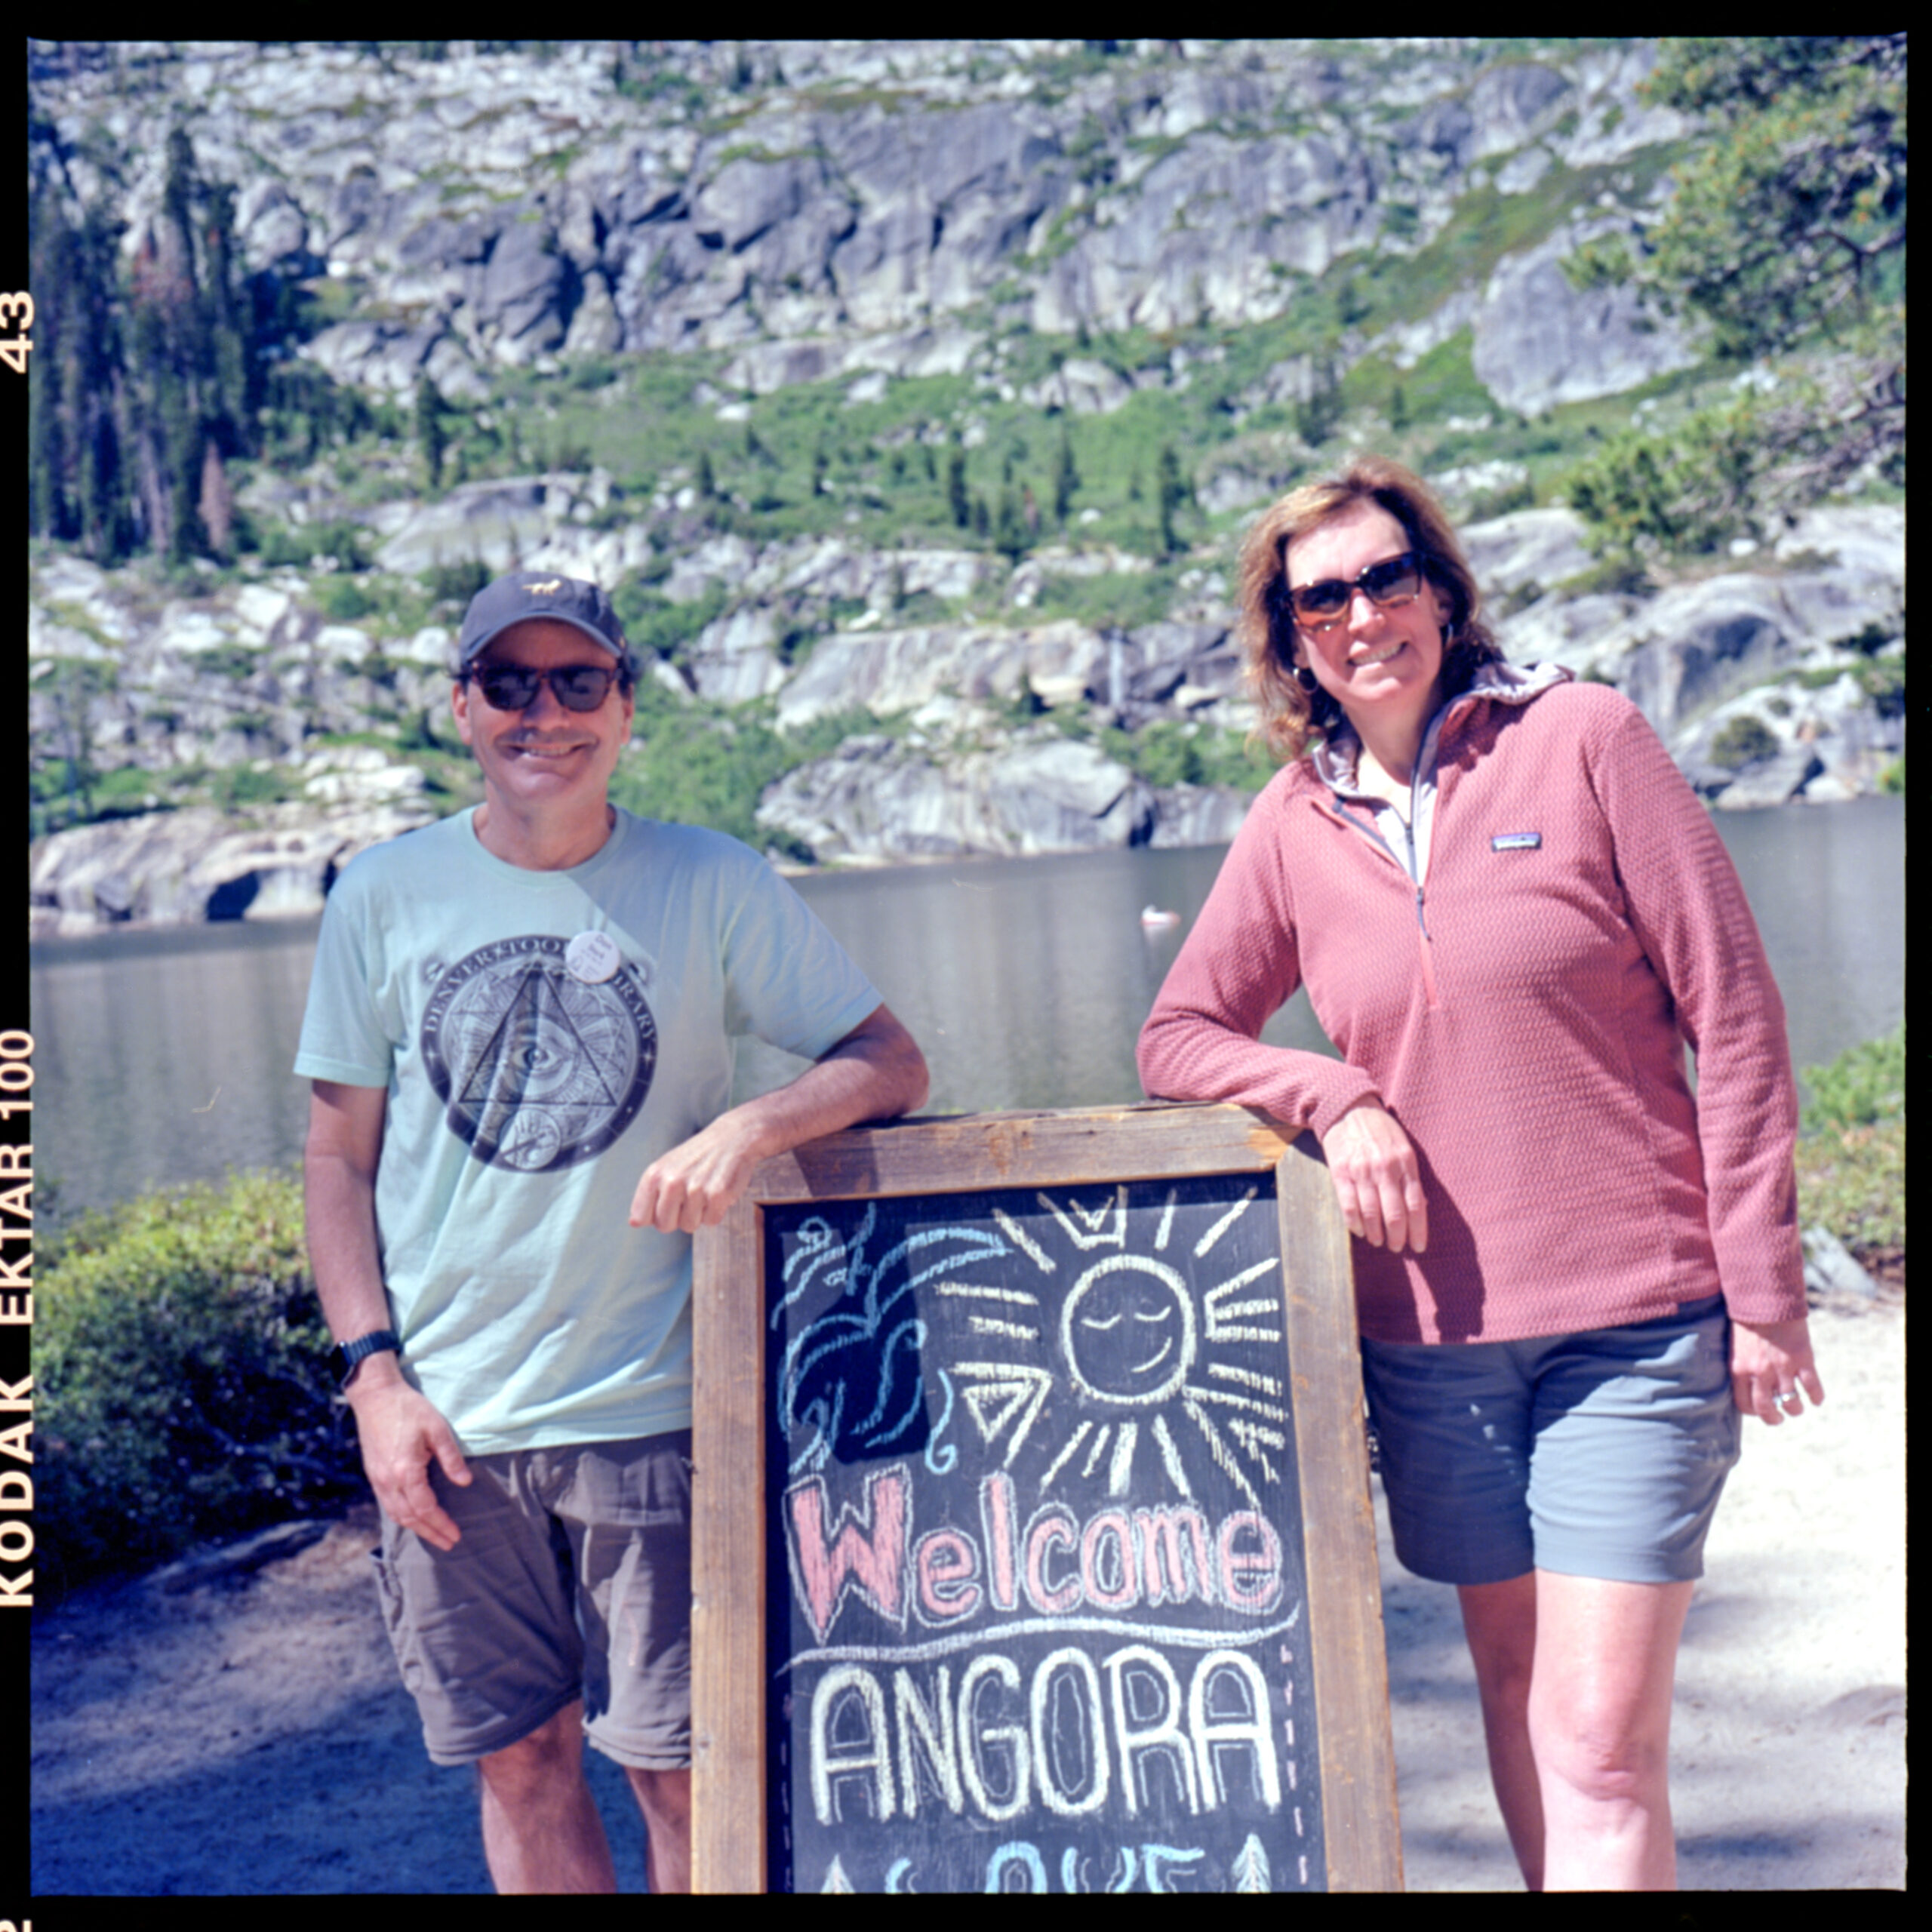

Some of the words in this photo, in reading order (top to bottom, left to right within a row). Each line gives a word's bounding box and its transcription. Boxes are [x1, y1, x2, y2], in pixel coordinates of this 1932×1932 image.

[424, 950, 491, 1032] DENVER
[782, 1463, 1284, 1646] Welcome
[809, 1644, 1282, 1826] ANGORA
